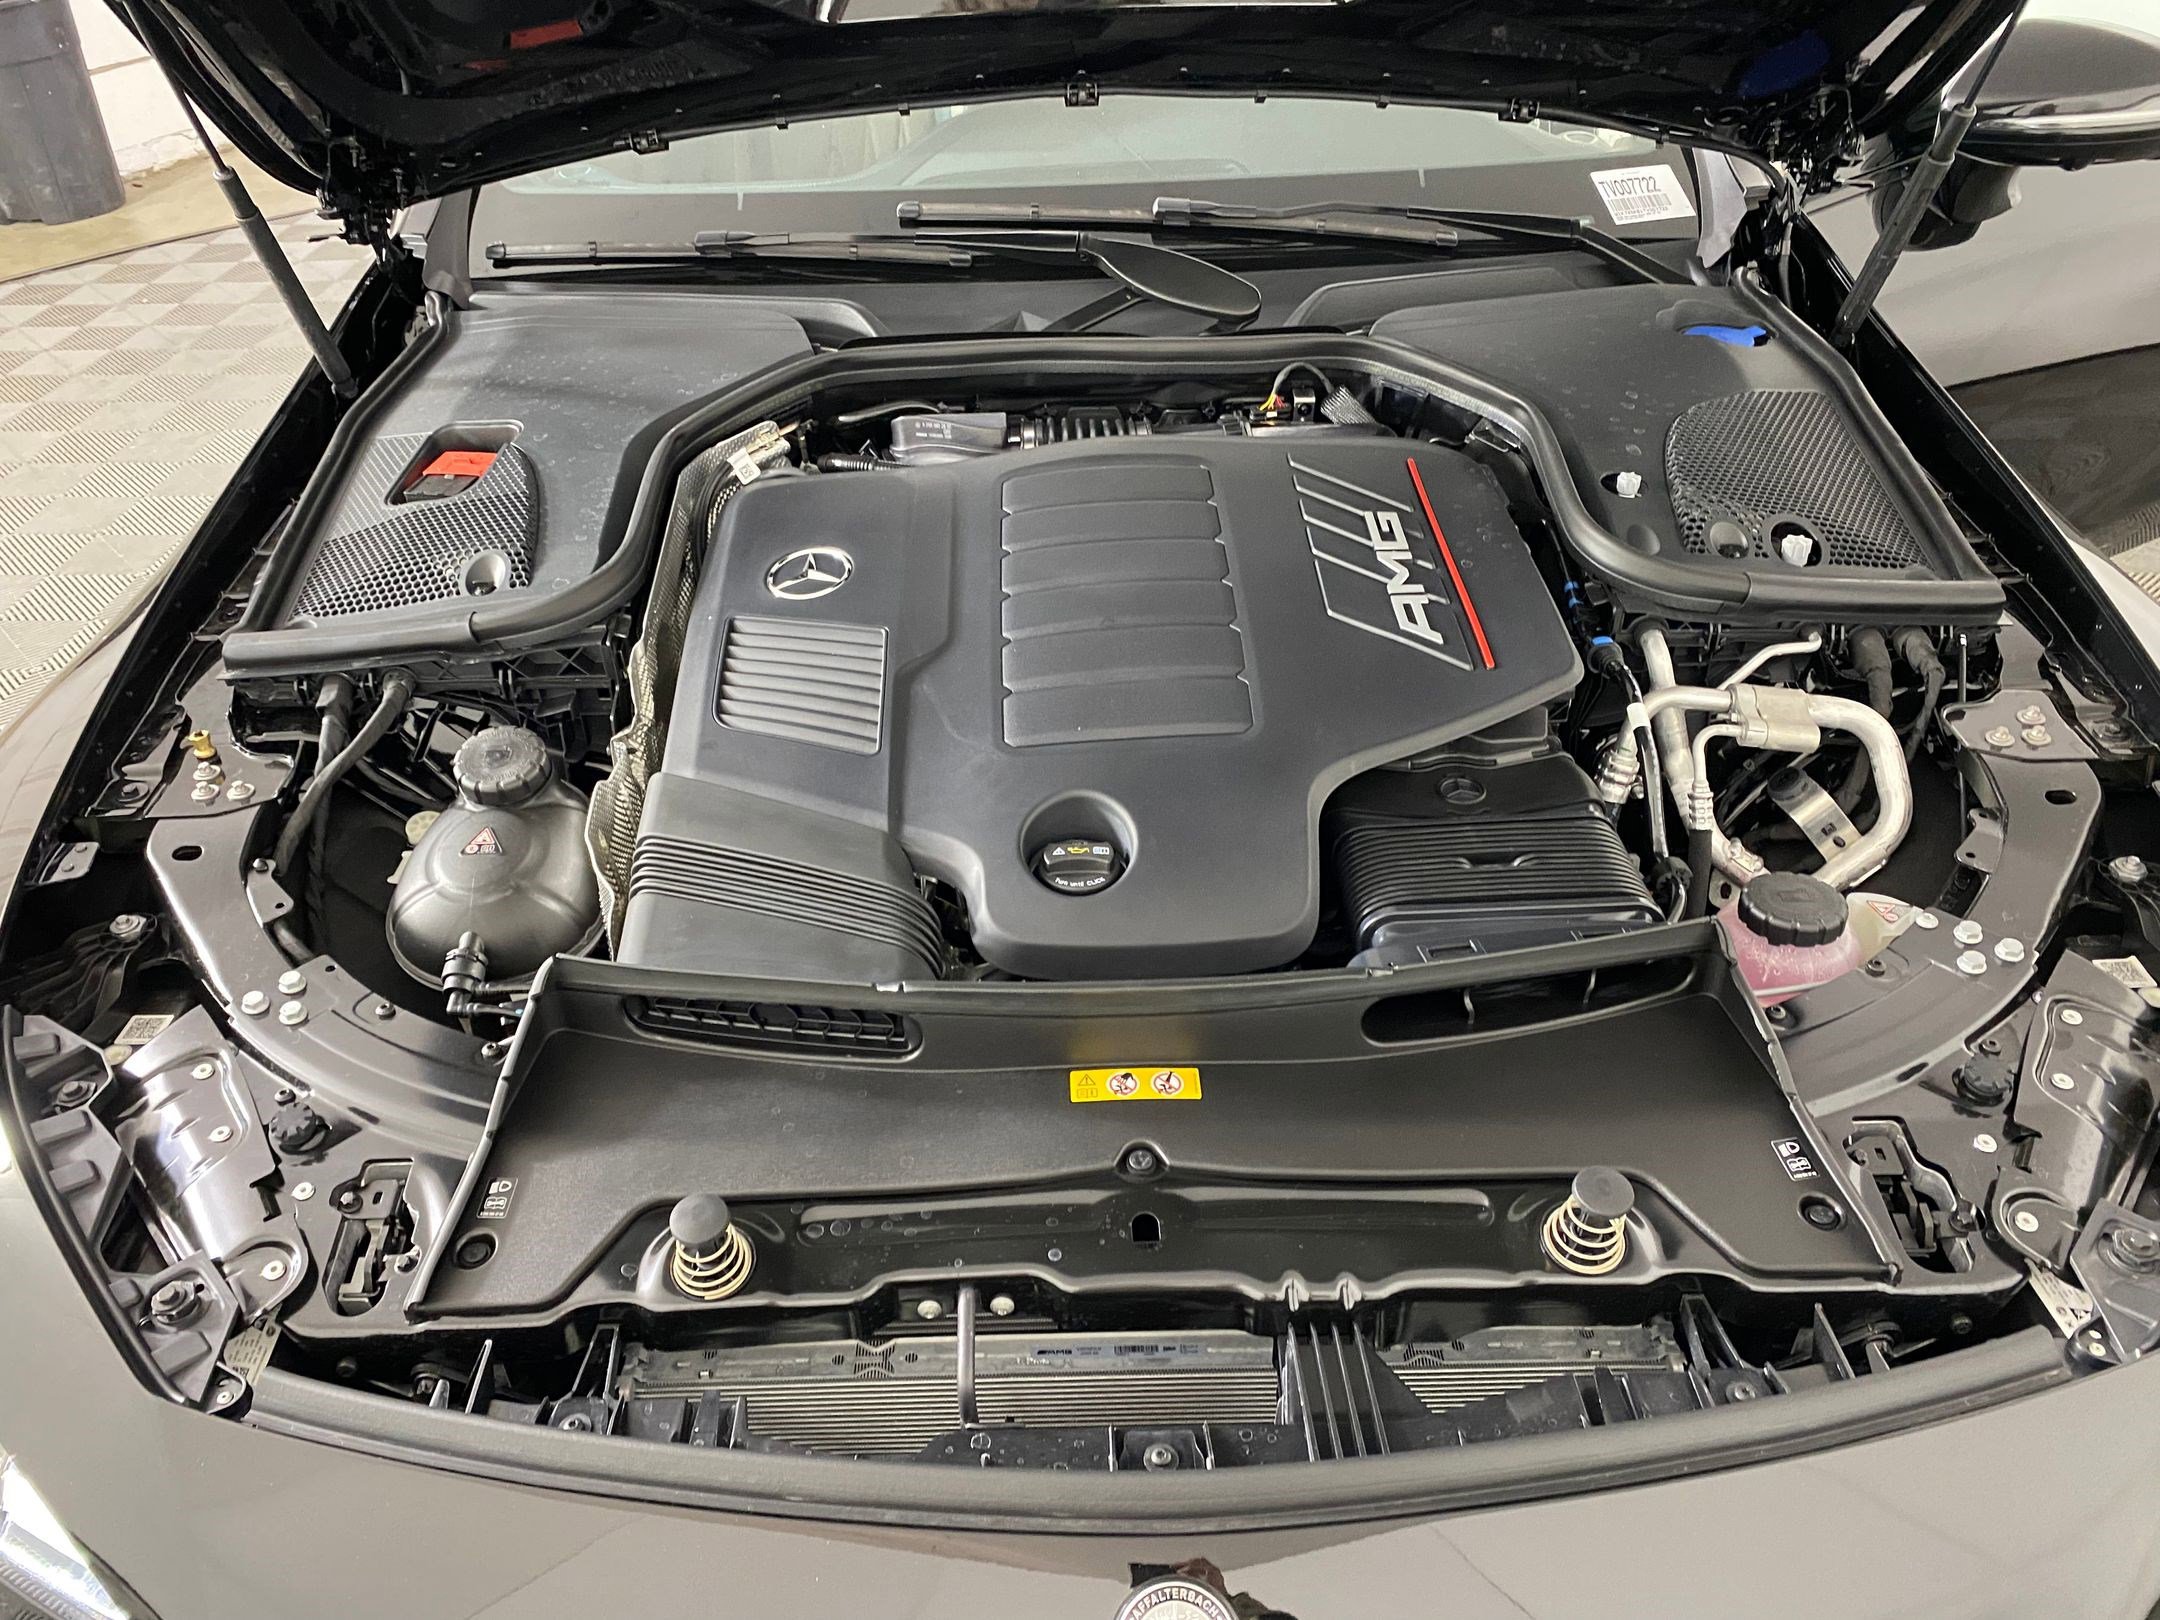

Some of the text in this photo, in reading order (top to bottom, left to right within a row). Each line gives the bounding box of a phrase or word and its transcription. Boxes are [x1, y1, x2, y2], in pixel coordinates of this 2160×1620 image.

[1598, 176, 1662, 198] TV007722
[1364, 511, 1444, 645] AMG
[1132, 1587, 1220, 1620] AFFALTERBACH
